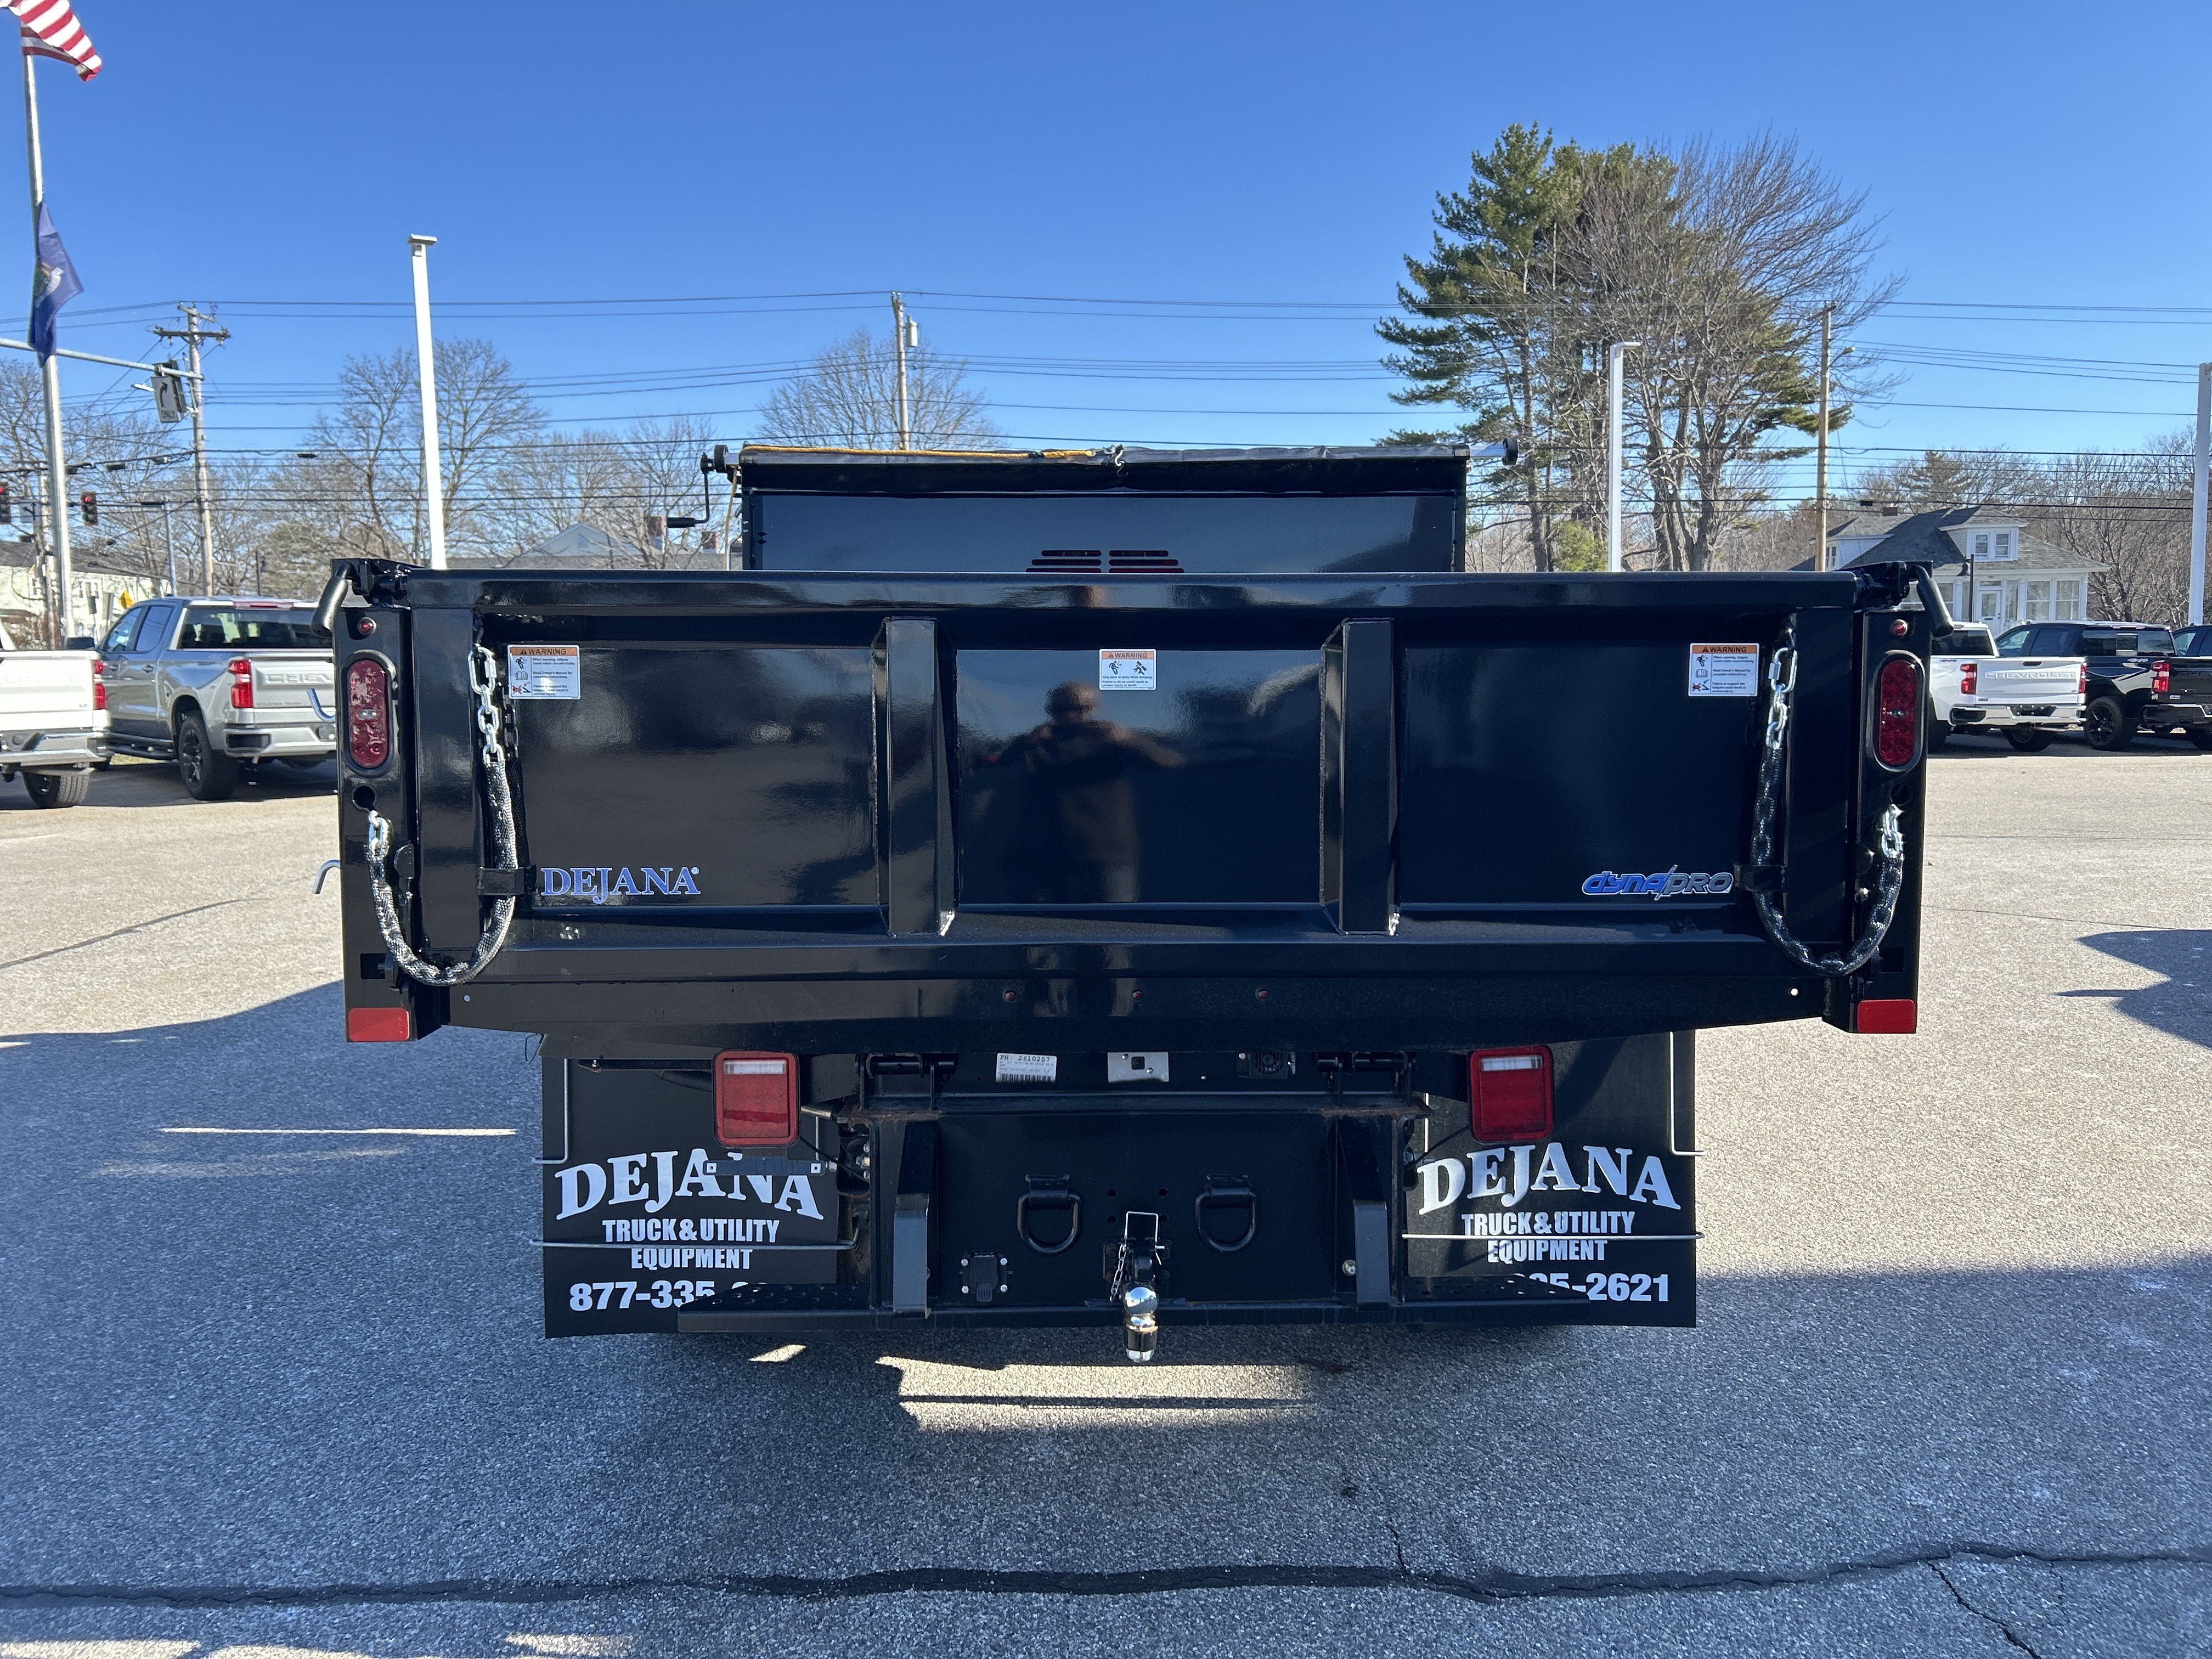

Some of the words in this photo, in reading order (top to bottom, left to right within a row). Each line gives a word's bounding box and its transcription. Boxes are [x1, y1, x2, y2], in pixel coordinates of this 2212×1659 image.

[161, 410, 174, 419] ONLY
[554, 1147, 824, 1221] DEJANA
[1417, 1142, 1681, 1216] DEJANA
[631, 1248, 753, 1271] EQUIPMENT
[1487, 1239, 1607, 1265] EQUIPMENT
